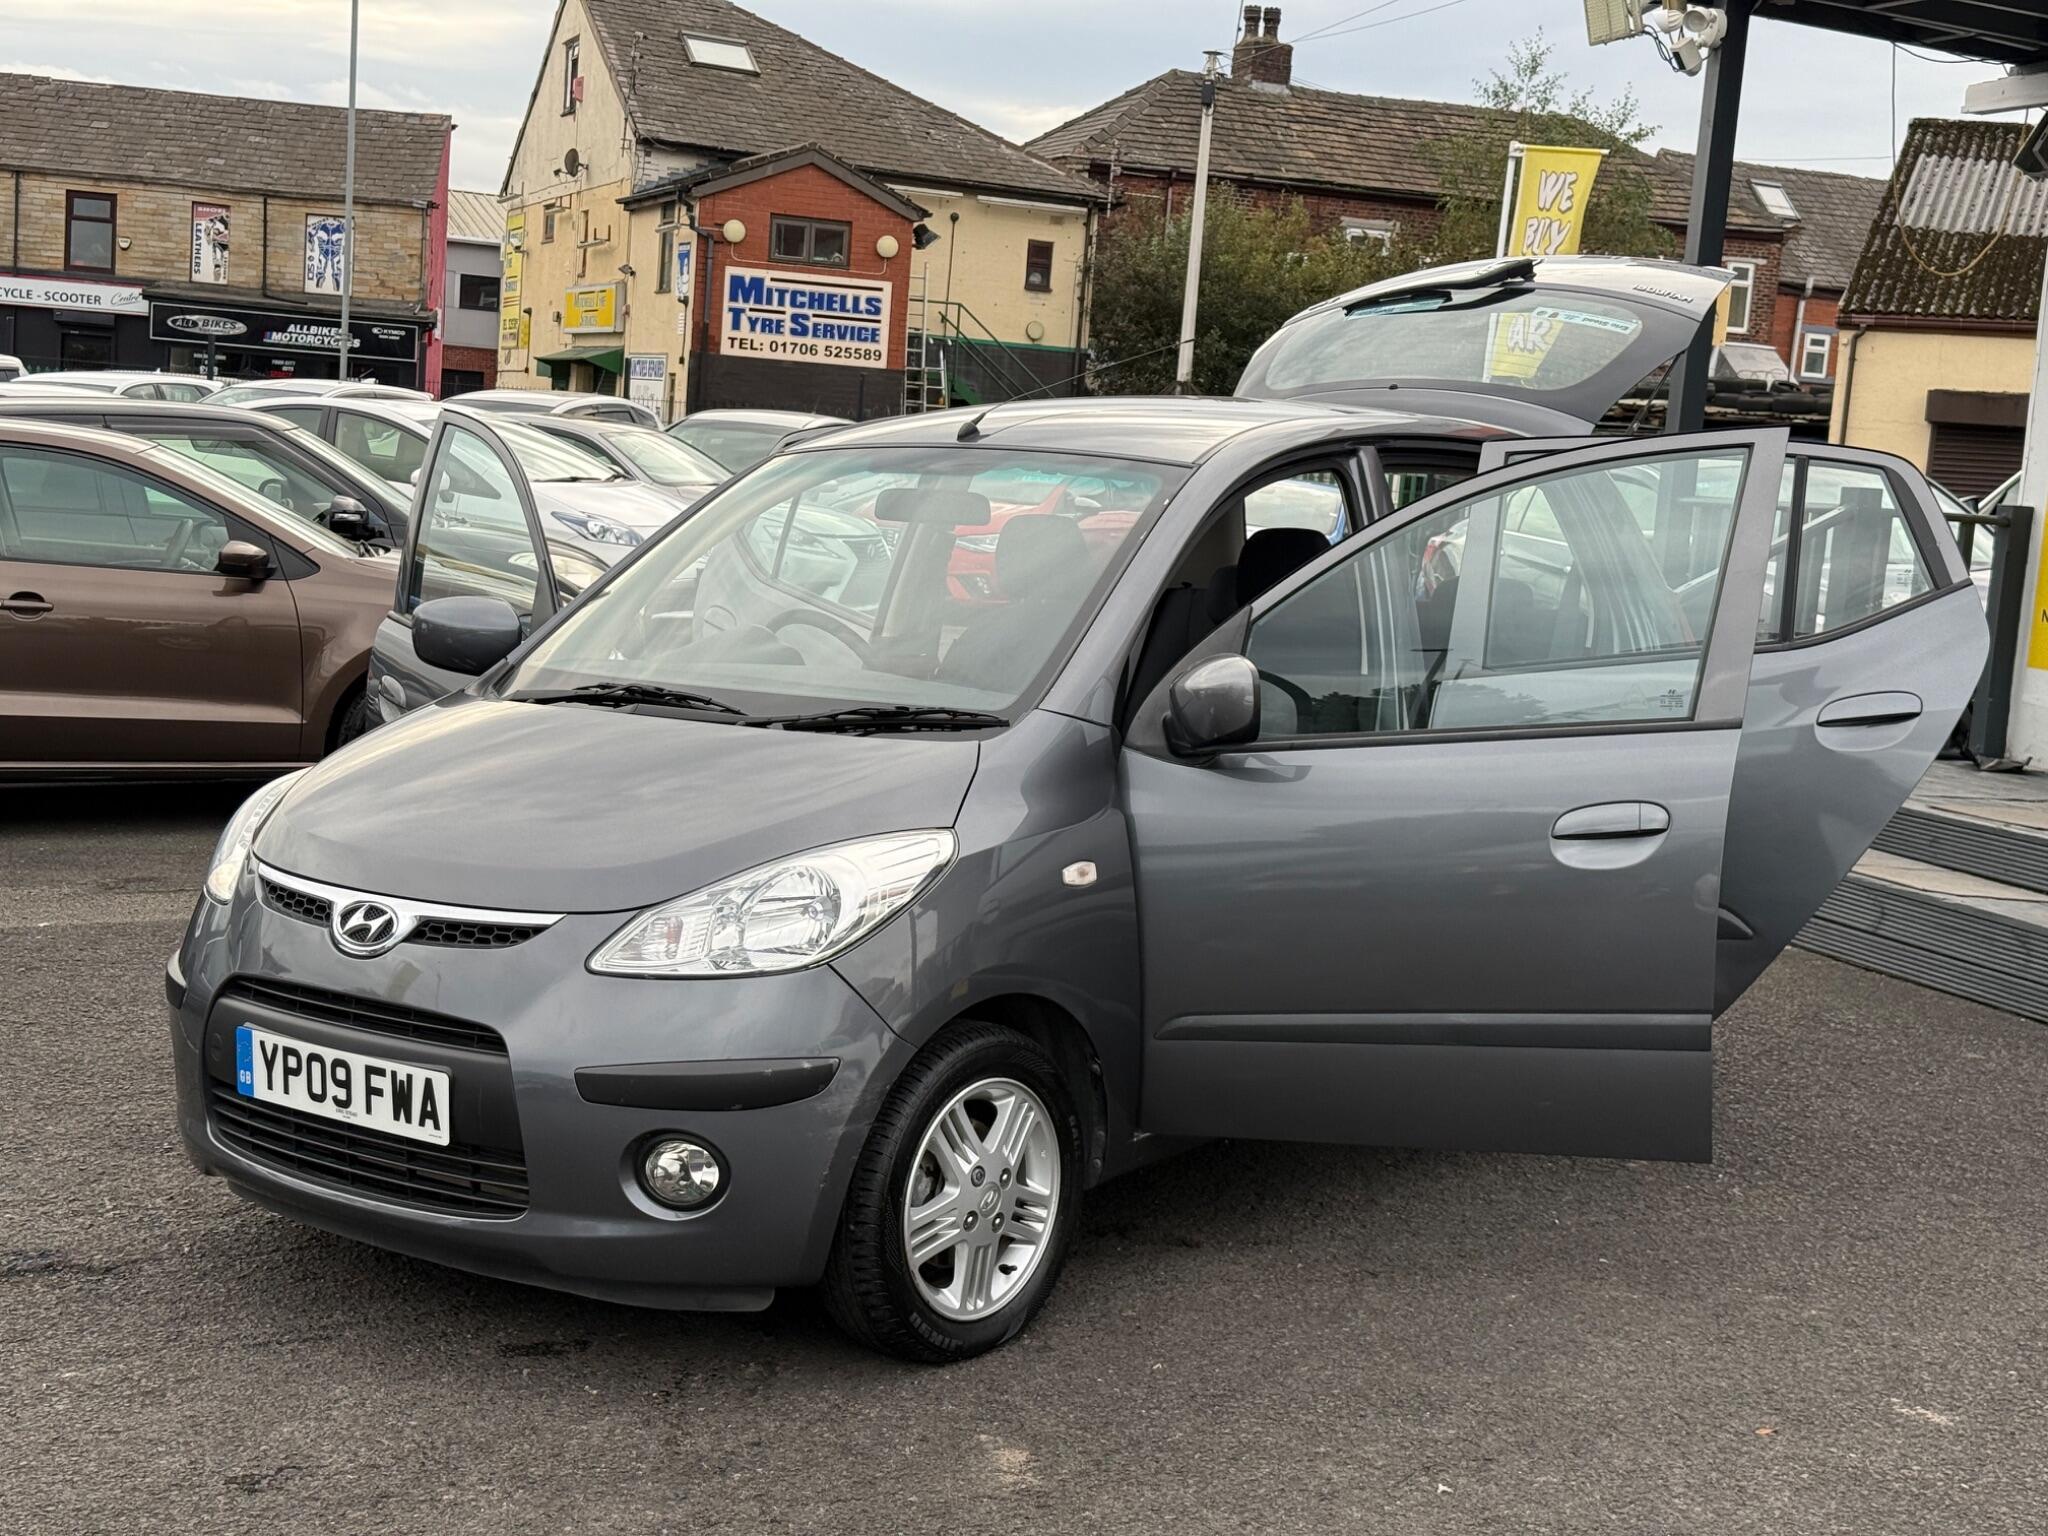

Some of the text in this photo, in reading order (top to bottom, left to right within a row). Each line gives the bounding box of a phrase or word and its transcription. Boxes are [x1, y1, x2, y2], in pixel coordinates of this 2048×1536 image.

[1538, 169, 1579, 214] WE
[194, 223, 202, 275] LEATHERS
[1522, 216, 1572, 256] BUY
[44, 291, 102, 306] SCOOTER
[110, 291, 140, 306] Centre
[729, 275, 883, 316] MITCHELLS
[175, 319, 237, 330] ALL BIKES
[727, 306, 881, 344] TYRE SERVICE
[728, 337, 882, 361] TEL: 01706 525589
[239, 1069, 252, 1085] GB
[259, 1040, 441, 1131] YP09 FWA
